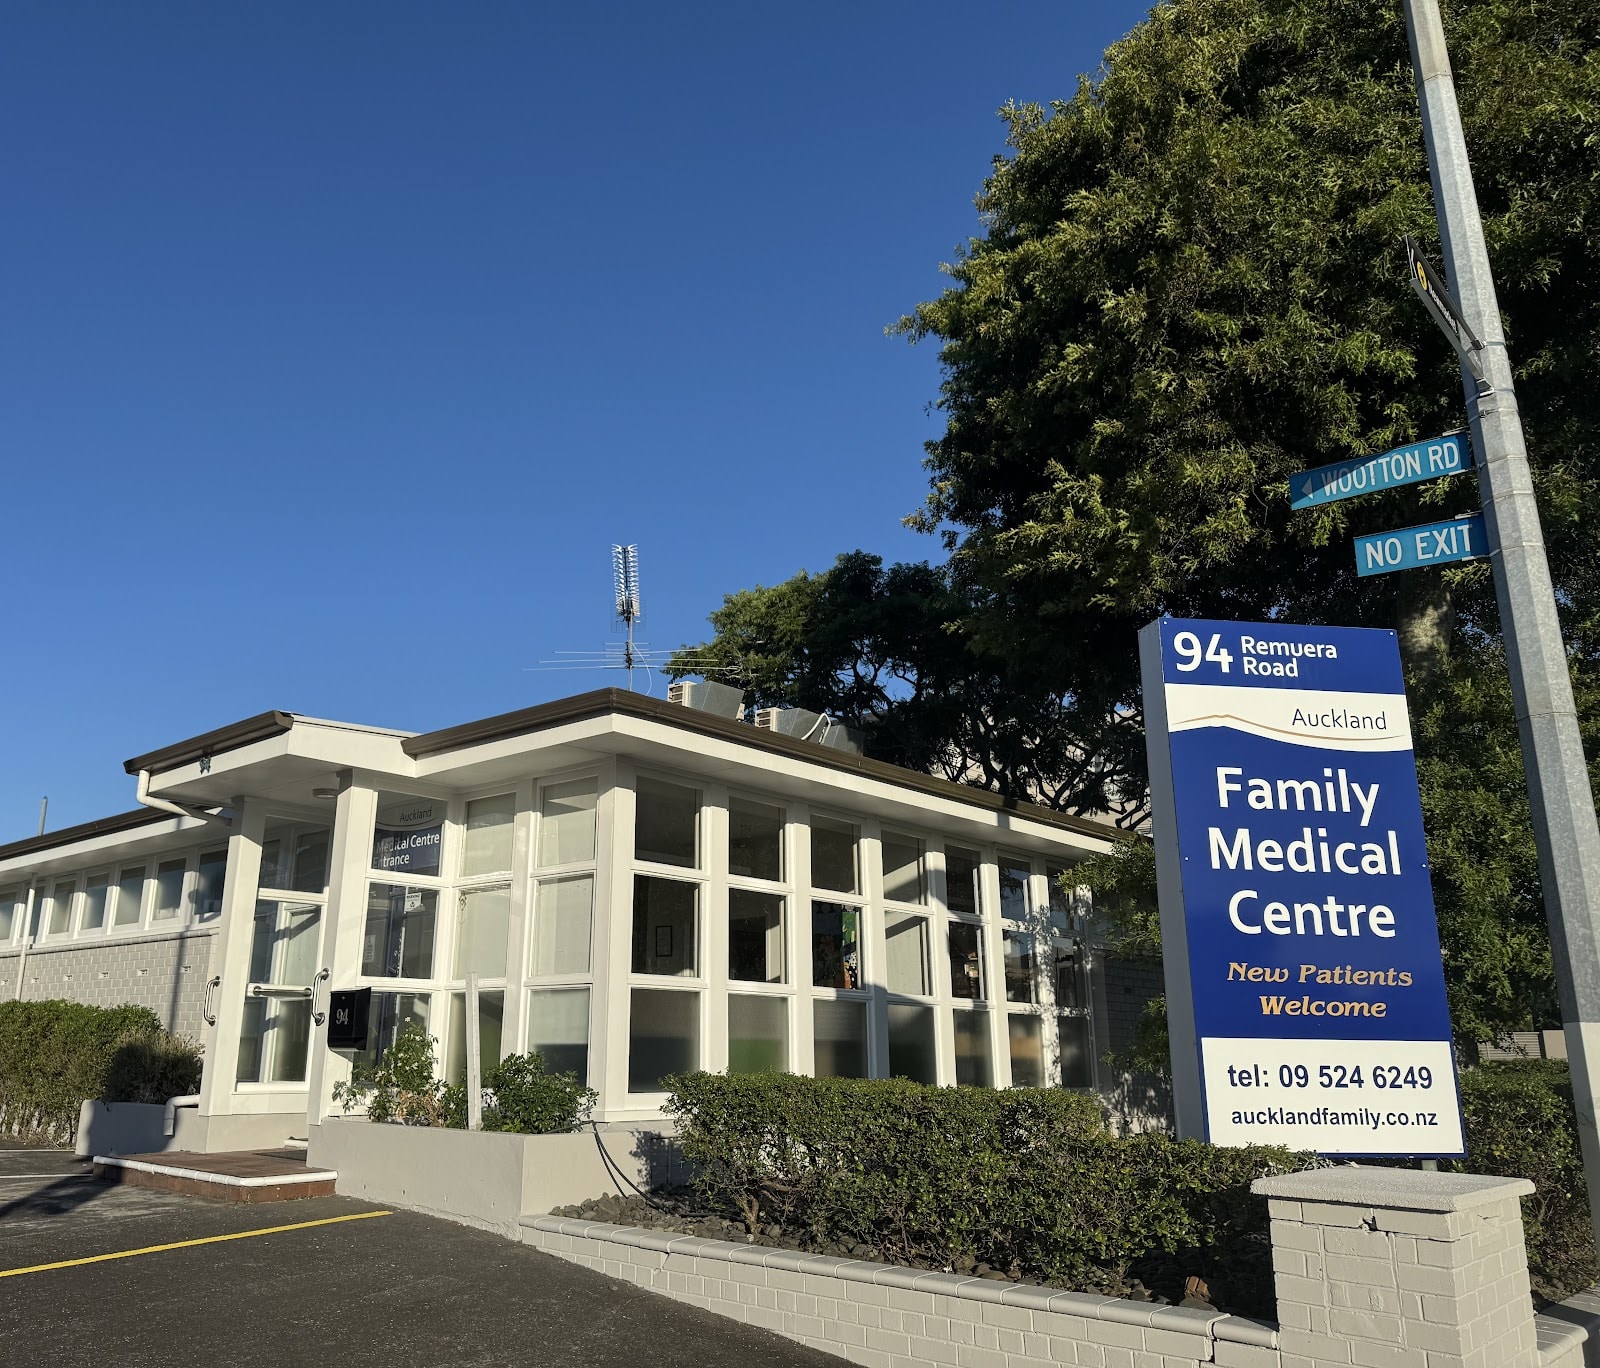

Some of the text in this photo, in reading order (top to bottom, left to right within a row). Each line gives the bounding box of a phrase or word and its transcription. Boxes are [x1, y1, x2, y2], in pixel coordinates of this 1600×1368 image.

[1321, 443, 1459, 496] WOOTTON RD
[1365, 524, 1473, 569] NO EXIT
[1173, 631, 1234, 673] 94
[1241, 636, 1338, 659] Remuera
[1243, 658, 1299, 678] Road
[1292, 708, 1387, 730] Auckland
[1216, 766, 1380, 827] Family
[400, 806, 433, 822] Auckland
[410, 833, 440, 848] Centre
[1208, 827, 1401, 876] Medical
[1228, 889, 1396, 938] Centre
[1226, 962, 1413, 987] New Patients
[336, 1008, 349, 1025] 94
[1259, 996, 1387, 1018] Welcome
[1227, 1064, 1432, 1090] tel: 09 524 6249
[1231, 1107, 1438, 1130] aucklandfamily.co.nz
